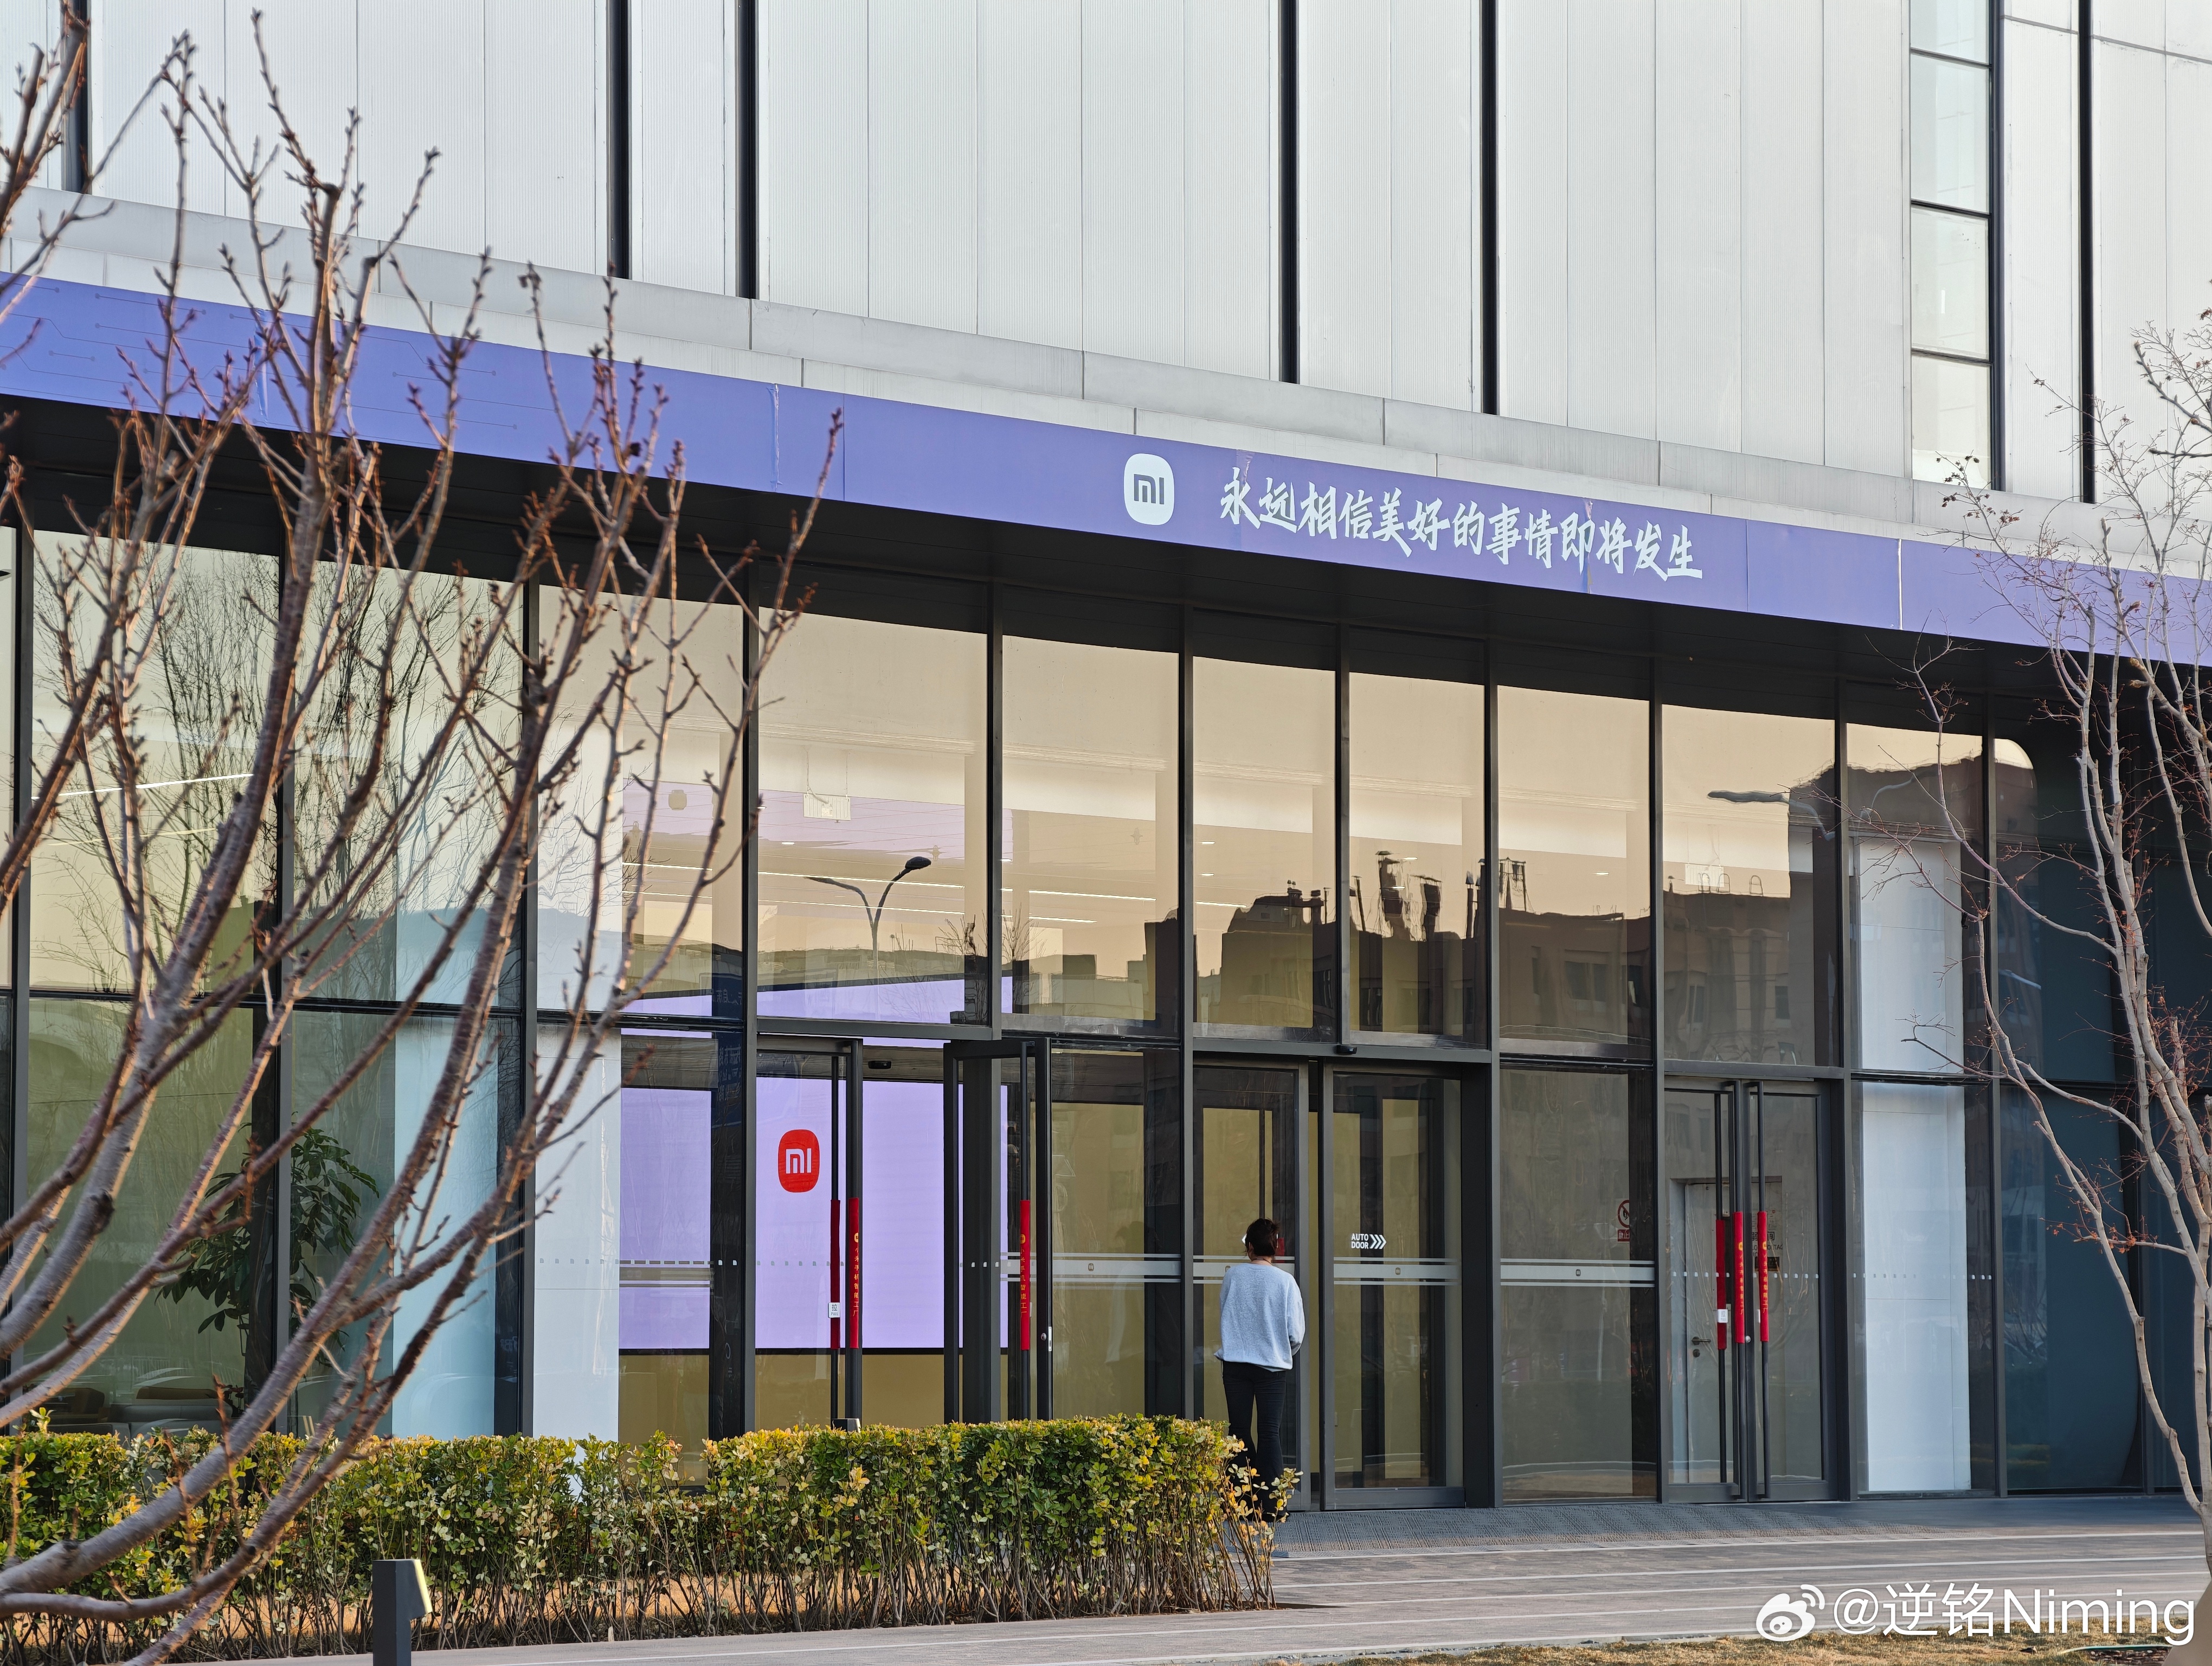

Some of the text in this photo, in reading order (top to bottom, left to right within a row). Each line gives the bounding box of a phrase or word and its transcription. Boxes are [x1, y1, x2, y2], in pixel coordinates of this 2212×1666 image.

[1220, 467, 1702, 581] 永远相信美好的事情即将发生
